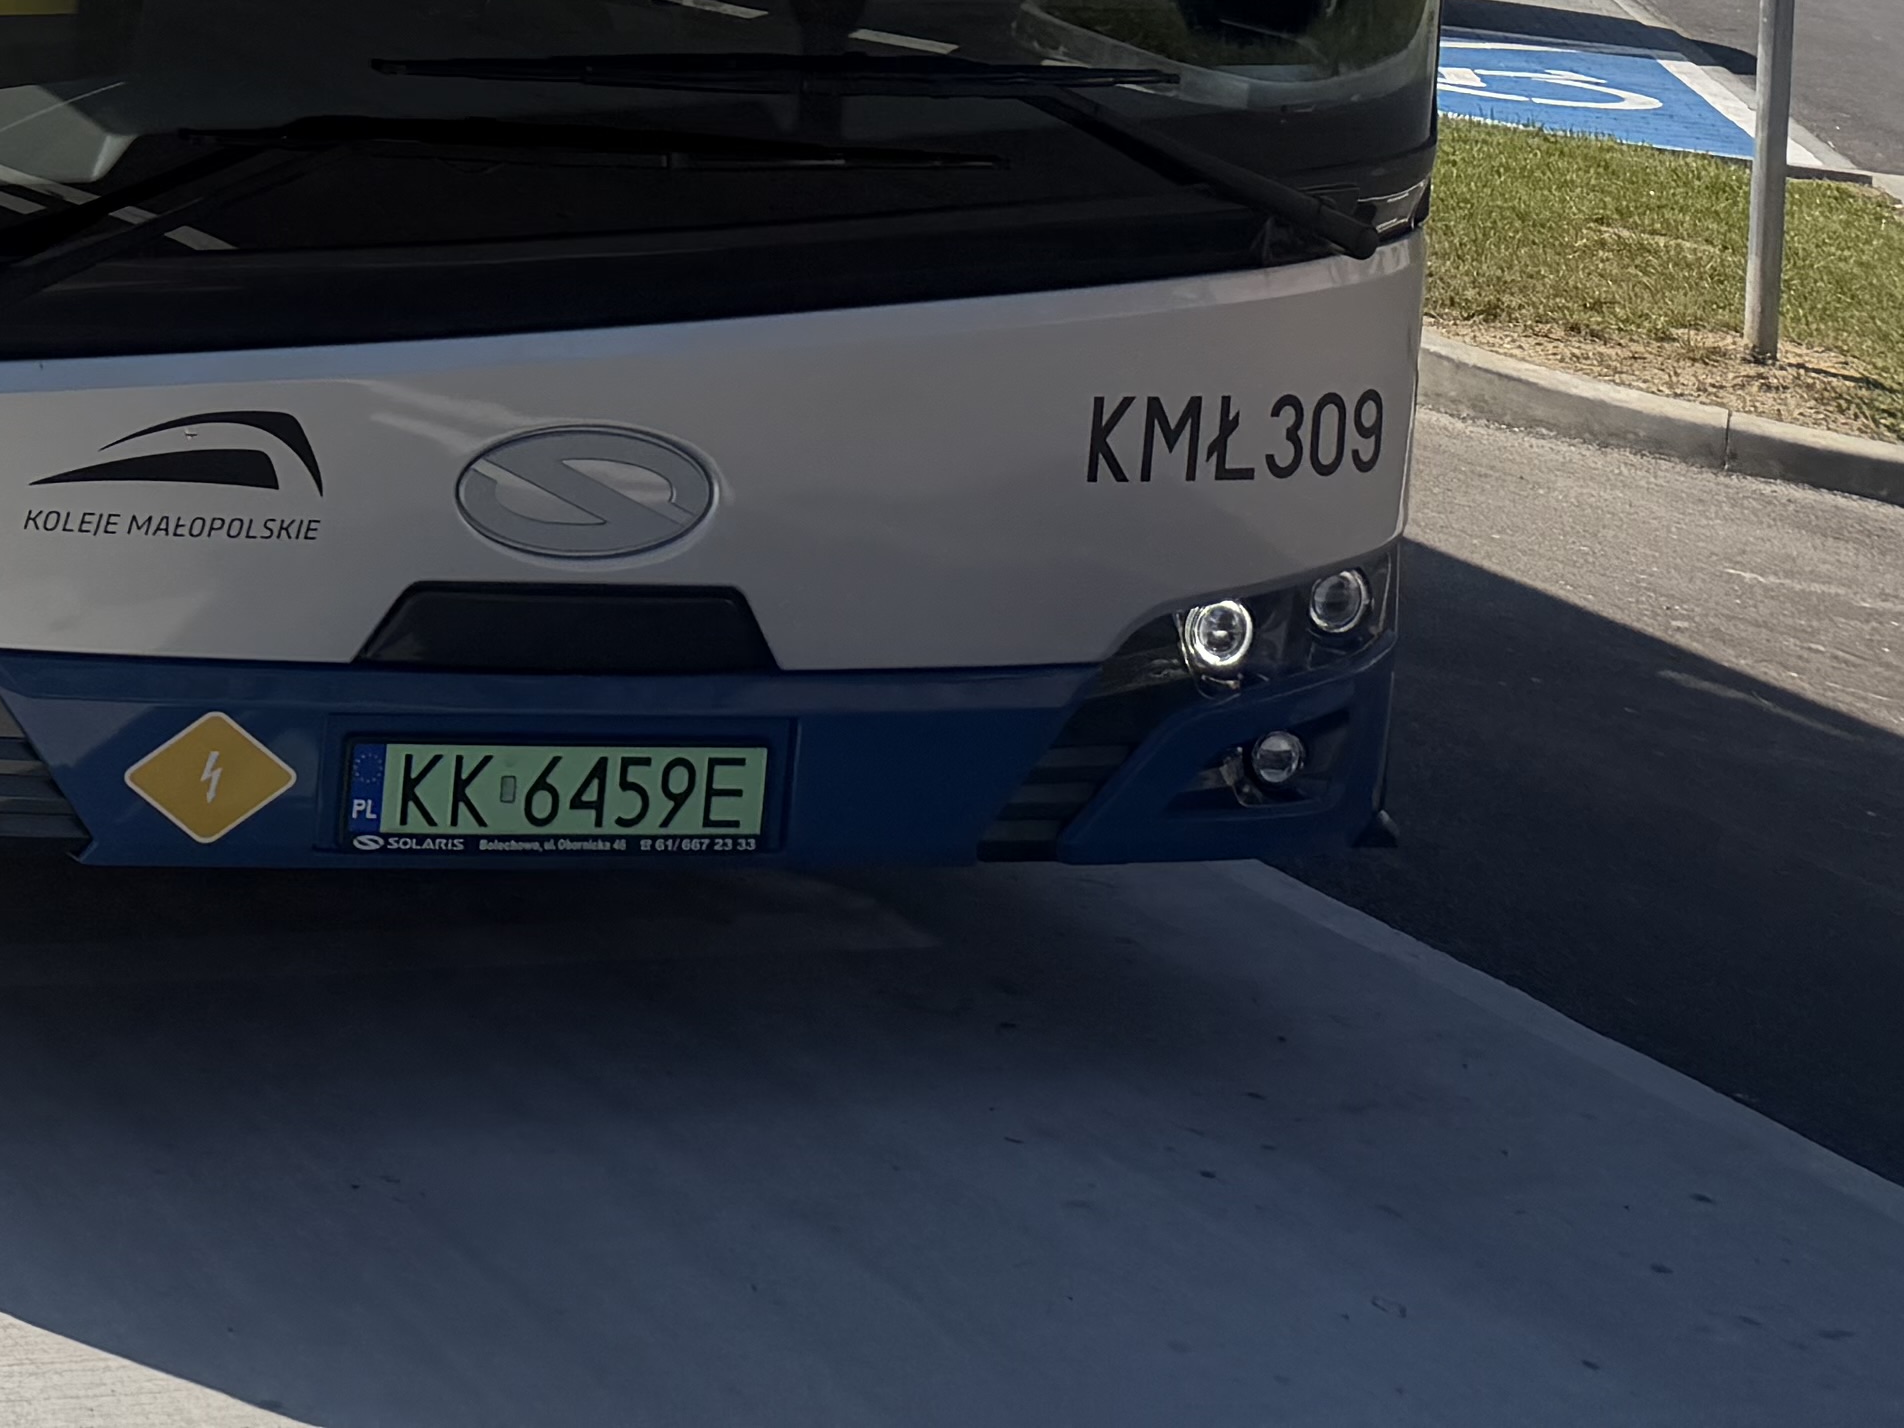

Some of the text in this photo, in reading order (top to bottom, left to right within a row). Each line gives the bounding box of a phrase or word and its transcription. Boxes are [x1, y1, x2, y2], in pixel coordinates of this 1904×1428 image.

[1086, 388, 1383, 483] KMŁ309
[23, 509, 321, 540] KOLEJE MAŁOPOLSKIE
[351, 799, 377, 819] PL
[387, 837, 465, 851] SOLARIS
